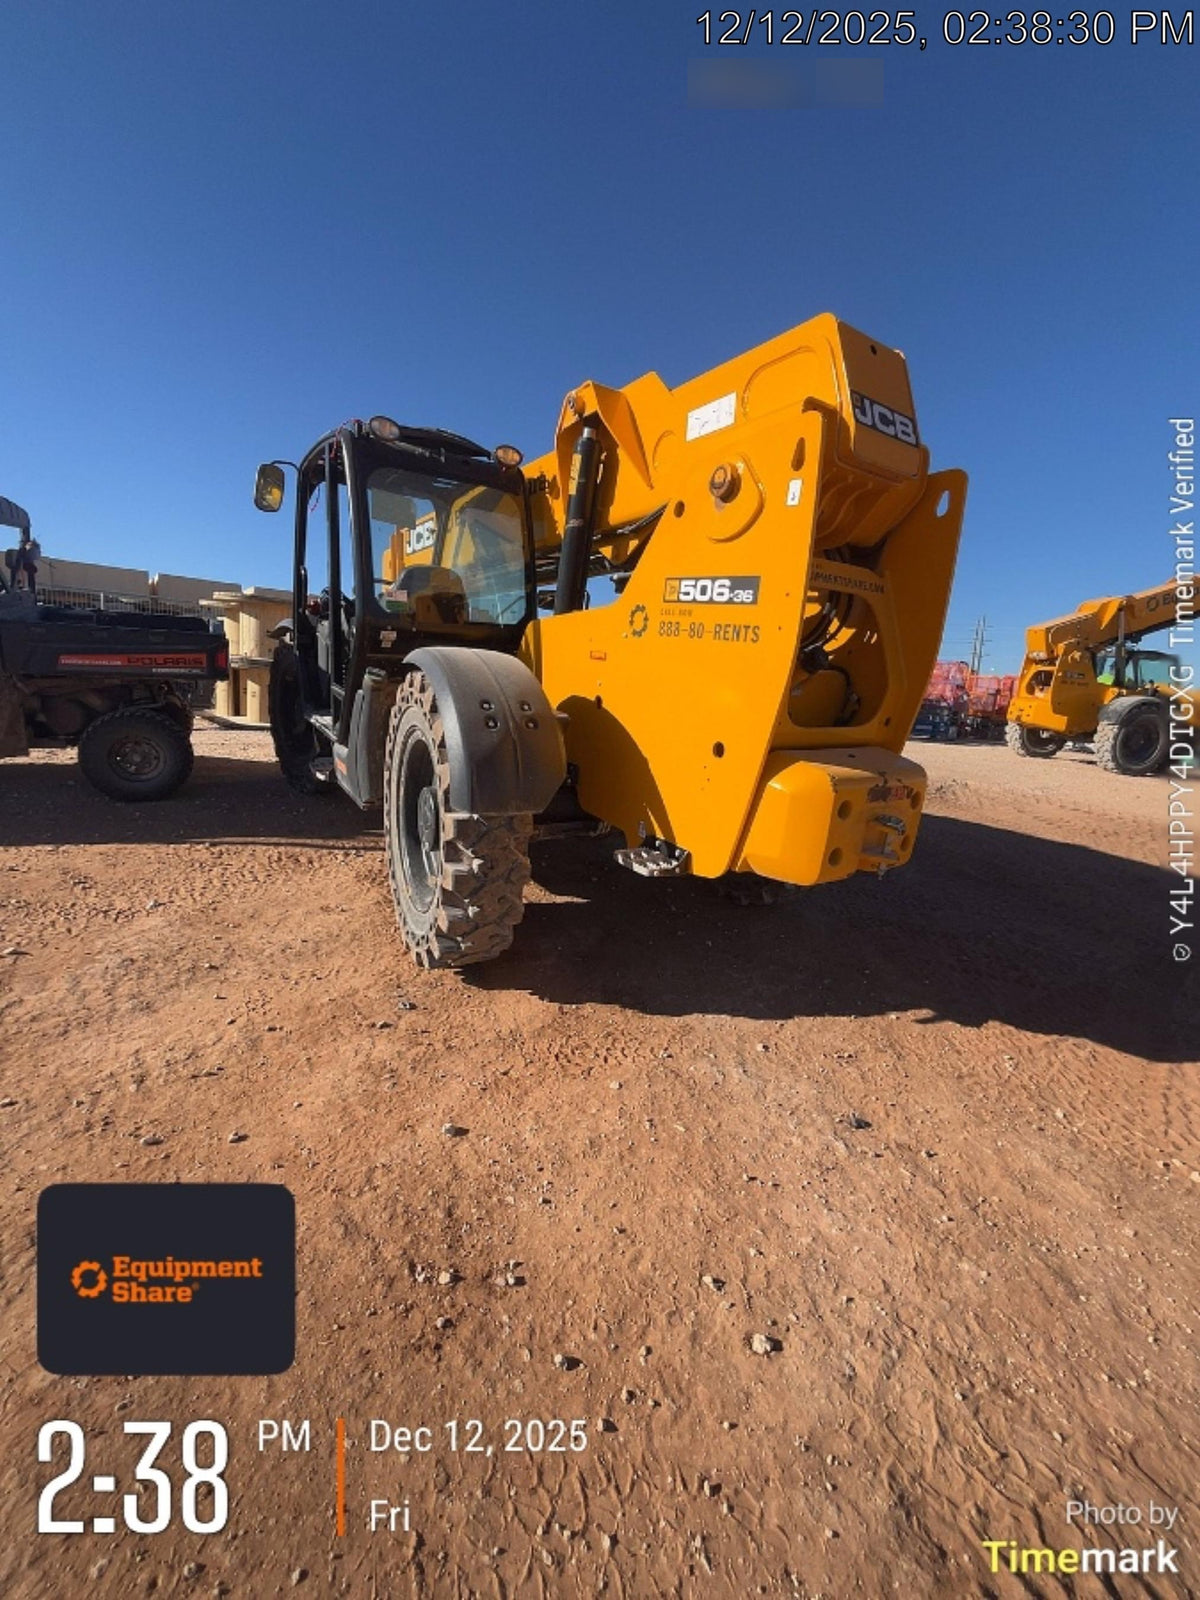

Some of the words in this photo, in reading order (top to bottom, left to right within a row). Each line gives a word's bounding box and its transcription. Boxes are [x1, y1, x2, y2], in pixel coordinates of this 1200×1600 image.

[855, 398, 917, 445] JCB
[406, 520, 436, 554] JCB
[658, 620, 760, 644] 888-80-RENTS
[127, 656, 203, 666] POLARIS
